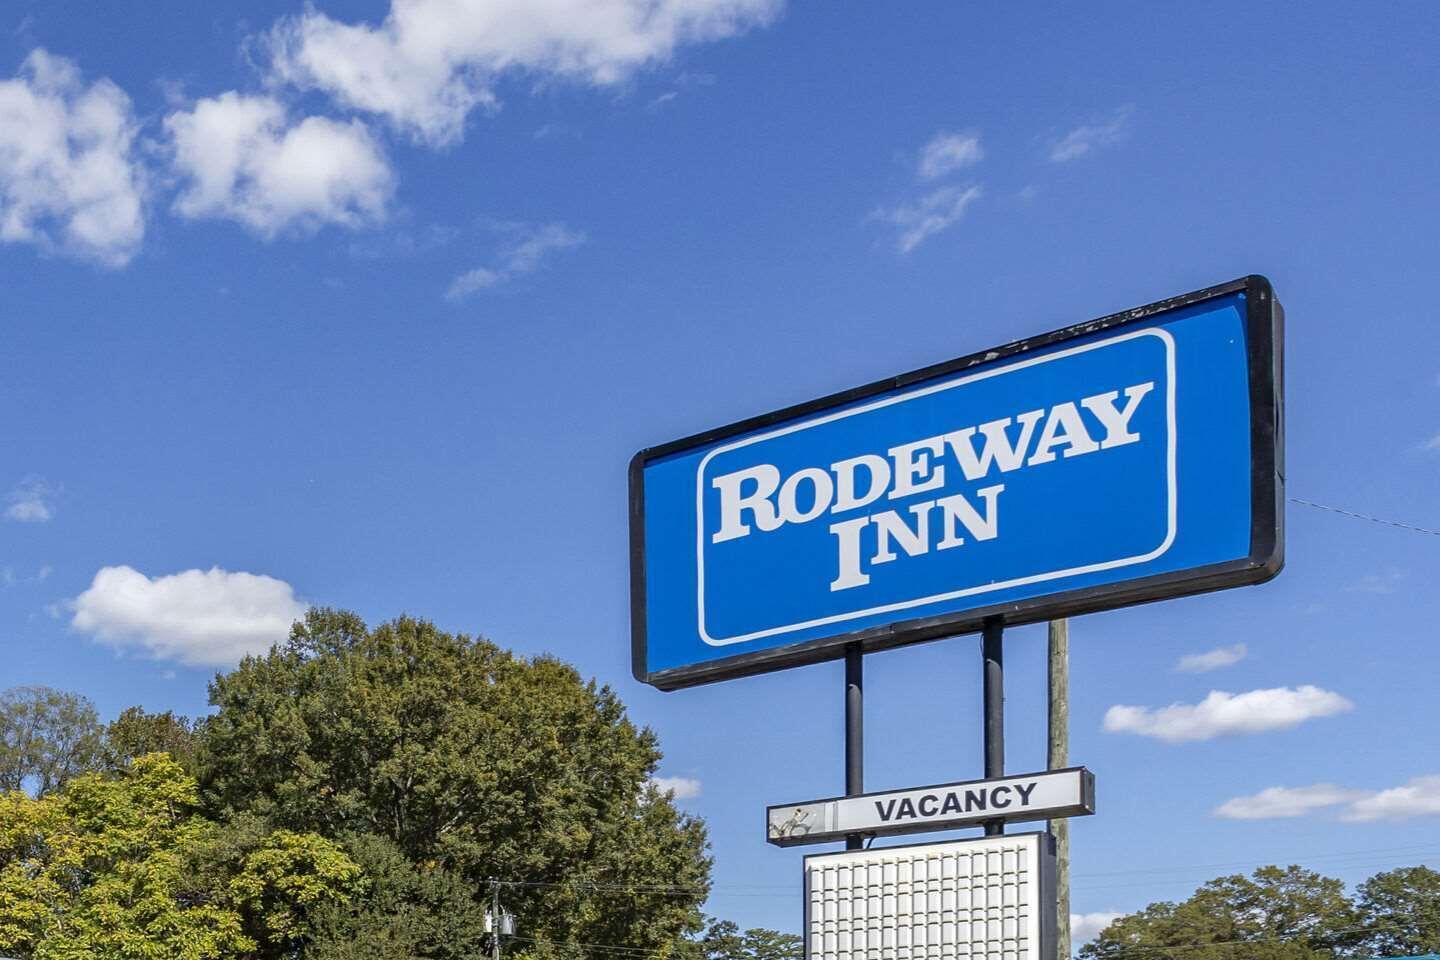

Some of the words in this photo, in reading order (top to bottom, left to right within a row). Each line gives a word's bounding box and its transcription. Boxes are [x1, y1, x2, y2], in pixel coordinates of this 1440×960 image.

[712, 381, 1154, 544] RODEWAY
[829, 484, 1005, 592] INN
[874, 782, 1038, 822] VACANCY
